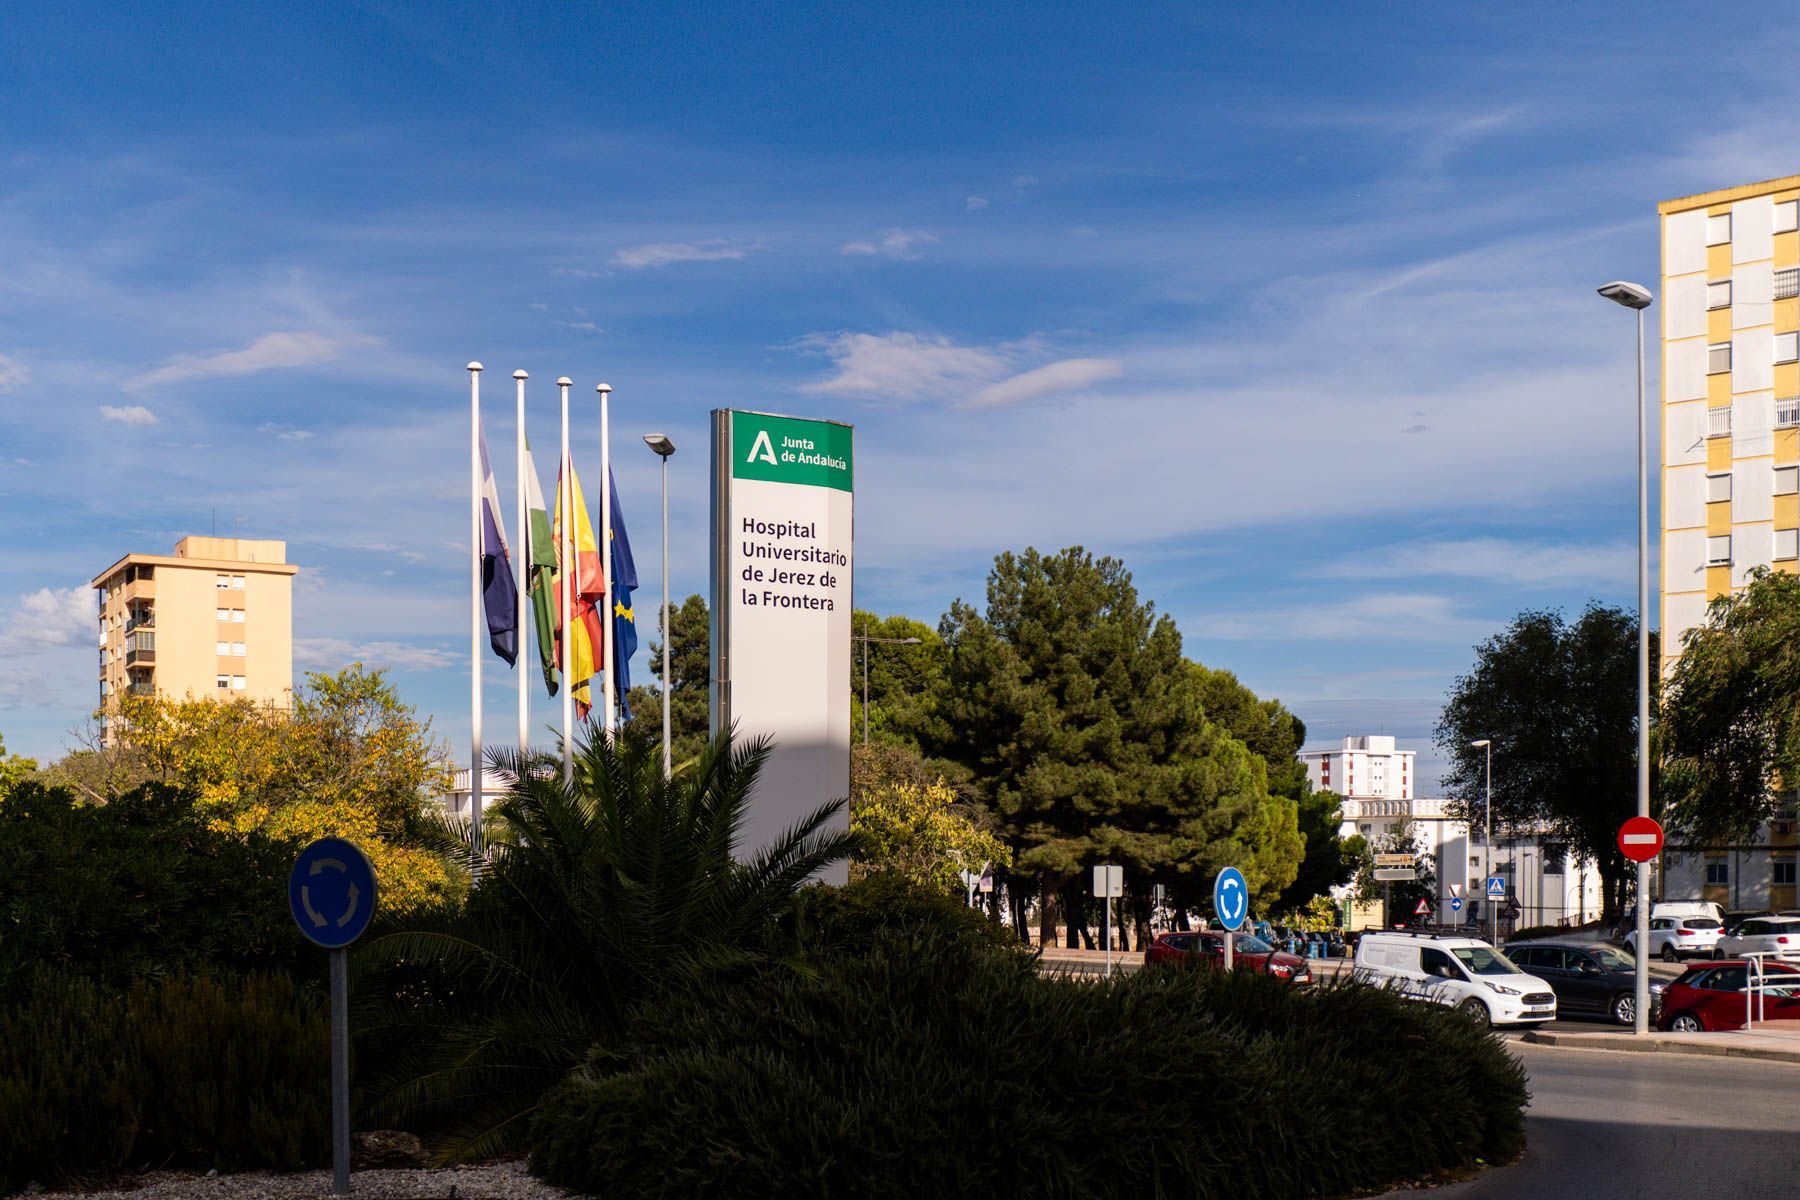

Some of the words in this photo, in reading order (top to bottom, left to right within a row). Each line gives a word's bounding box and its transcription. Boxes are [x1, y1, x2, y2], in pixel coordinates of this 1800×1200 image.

[781, 436, 814, 450] Junta
[781, 450, 796, 463] de
[797, 452, 847, 470] Andalucía
[743, 518, 816, 539] Hospital
[743, 541, 847, 567] Universitario
[742, 565, 763, 582] de
[768, 568, 815, 586] Jerez
[820, 571, 837, 588] de
[742, 589, 757, 606] la
[763, 591, 834, 611] Frontera
